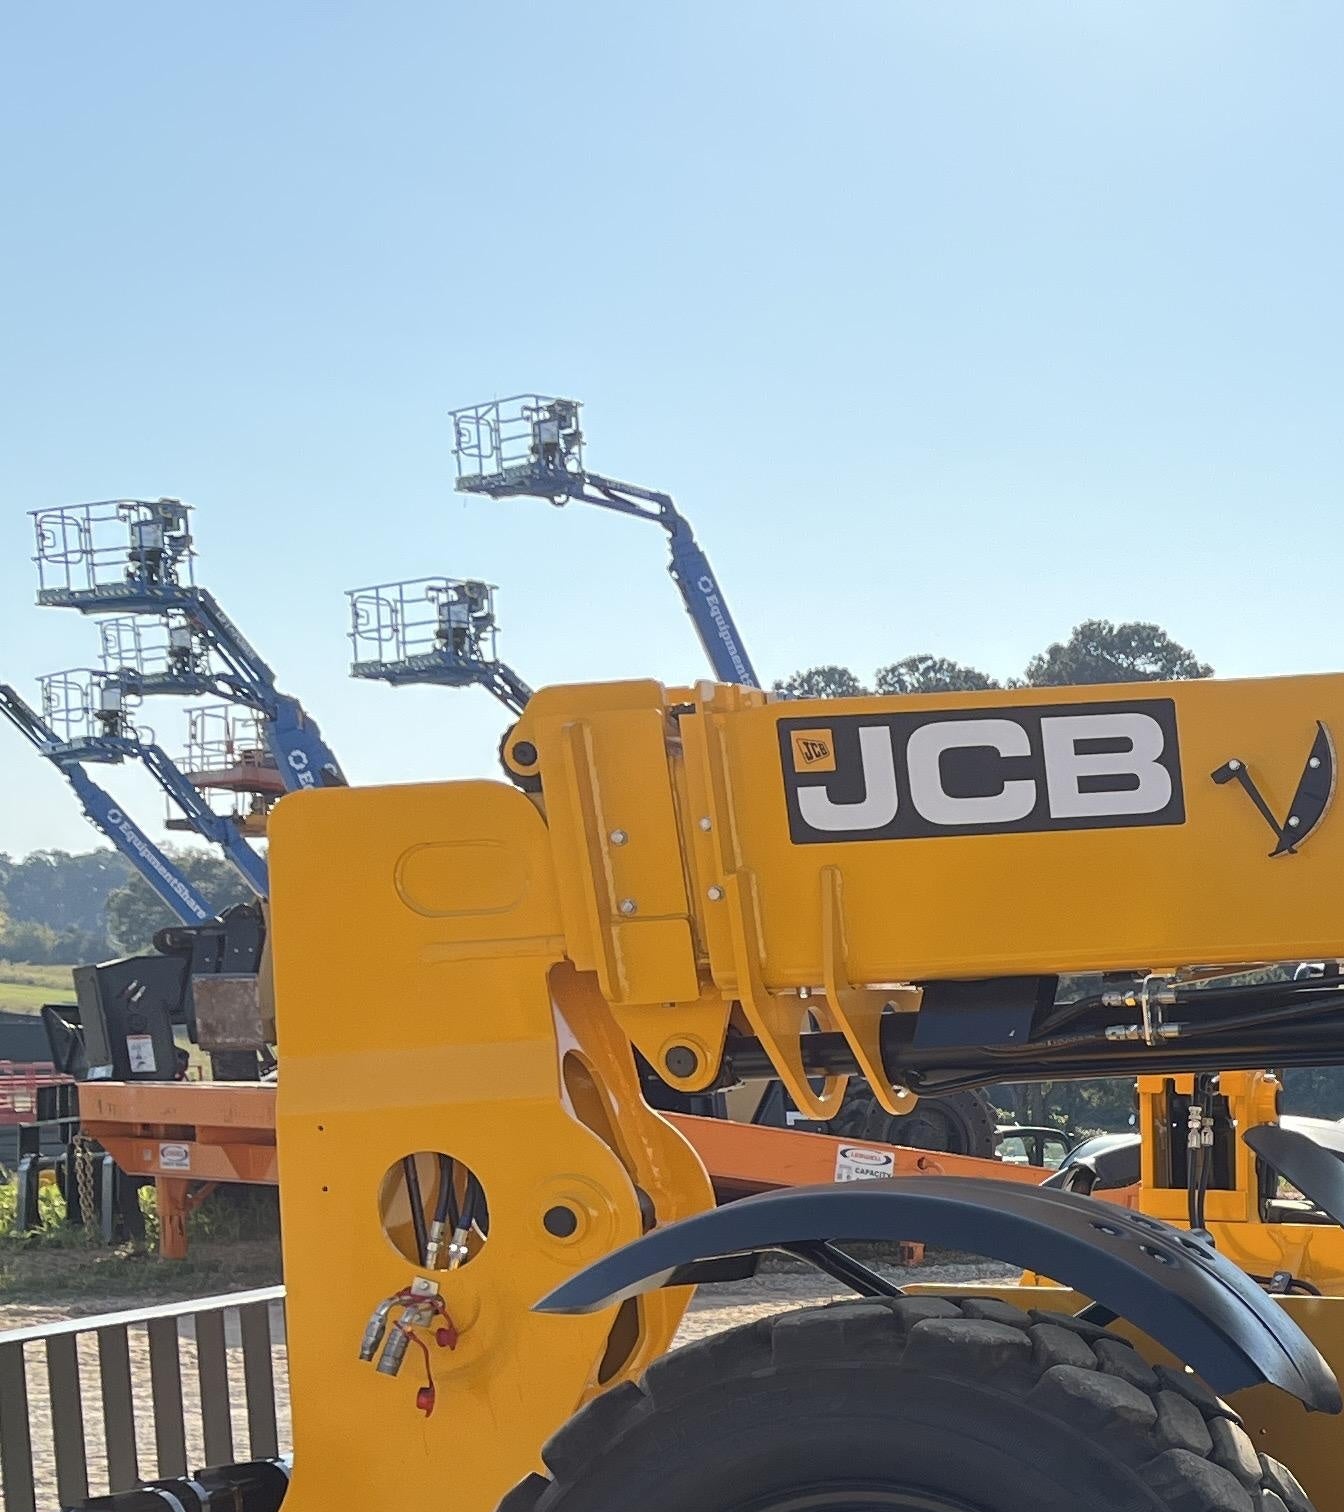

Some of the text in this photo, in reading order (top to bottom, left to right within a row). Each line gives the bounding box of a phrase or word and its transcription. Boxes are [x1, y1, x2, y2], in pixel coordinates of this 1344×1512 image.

[796, 712, 1173, 832] JCB
[801, 737, 831, 764] JCB
[118, 821, 207, 920] EquipmentShare
